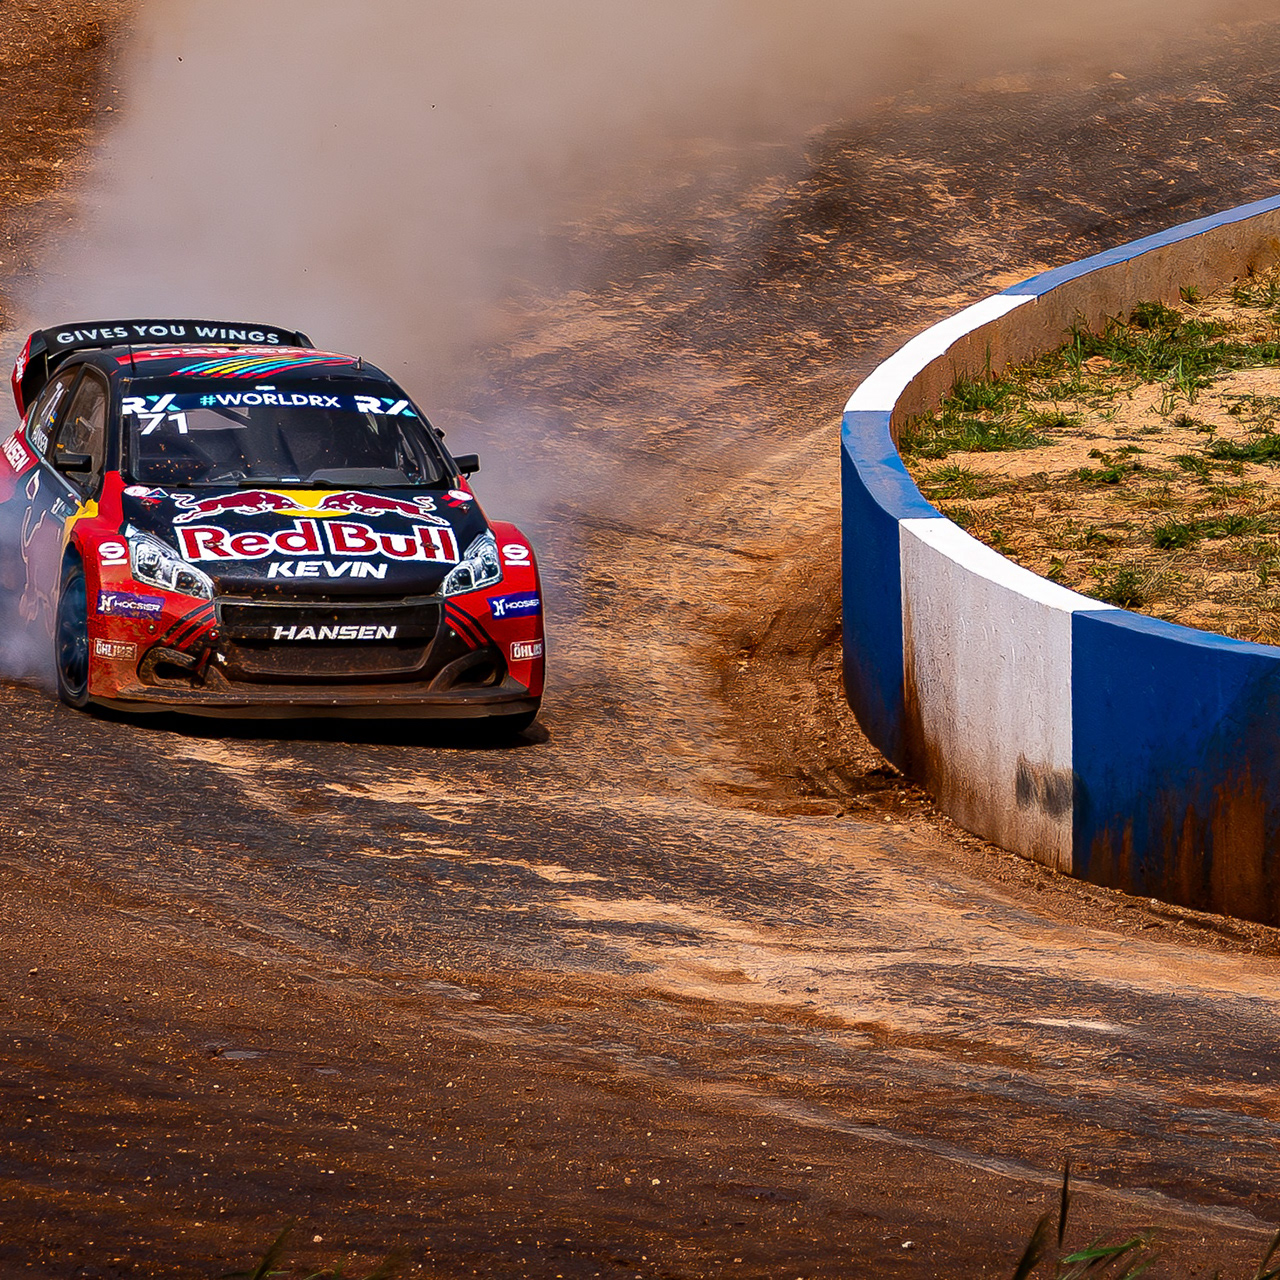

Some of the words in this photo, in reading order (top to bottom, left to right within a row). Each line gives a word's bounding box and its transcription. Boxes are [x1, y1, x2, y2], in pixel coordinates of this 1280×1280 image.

[56, 326, 128, 344] GIVES
[133, 325, 185, 337] YOU
[195, 326, 280, 345] WINGS
[200, 393, 341, 408] #WORLDRX
[137, 412, 189, 436] 71
[175, 519, 323, 562] Red
[323, 521, 459, 563] Bull
[267, 560, 388, 580] KEVIN
[272, 625, 397, 640] HANSEN
